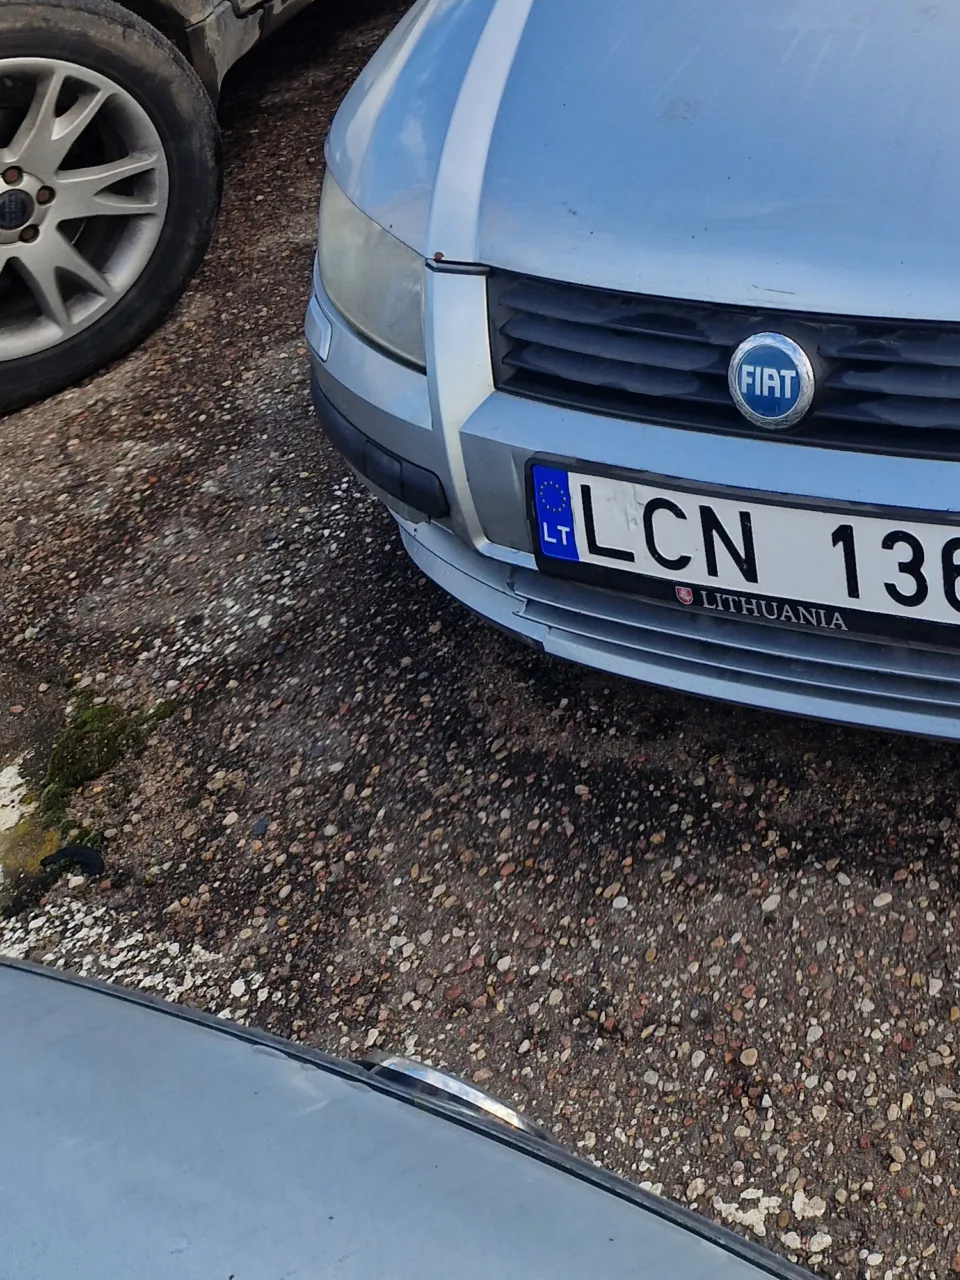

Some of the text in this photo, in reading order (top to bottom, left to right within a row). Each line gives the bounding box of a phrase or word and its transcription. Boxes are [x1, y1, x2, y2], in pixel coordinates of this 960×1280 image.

[741, 364, 797, 399] FIAT
[542, 521, 571, 546] LT
[580, 484, 759, 584] LCN
[700, 590, 849, 631] LITHUANIA
